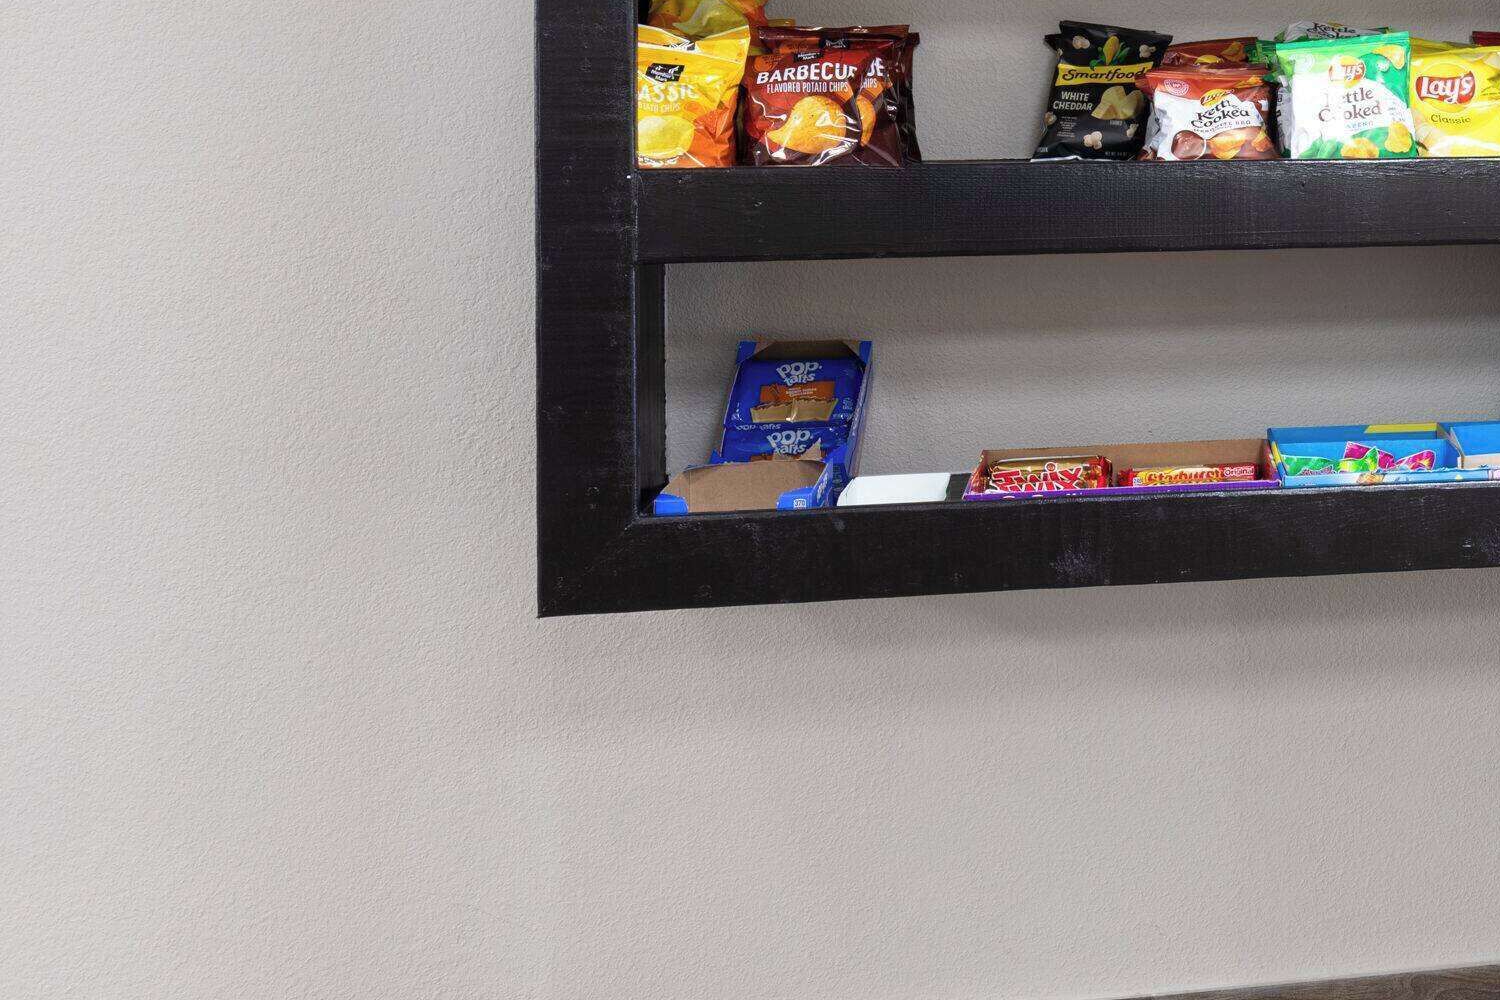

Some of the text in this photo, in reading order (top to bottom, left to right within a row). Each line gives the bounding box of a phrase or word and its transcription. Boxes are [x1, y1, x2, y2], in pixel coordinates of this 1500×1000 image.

[756, 61, 858, 85] BARBECUE
[1062, 66, 1147, 81] Smartfood
[767, 81, 849, 94] FLAVORED POTATO CHIPS
[860, 77, 878, 89] HIPS
[1420, 73, 1474, 105] Lay's
[637, 81, 701, 104] ASSIC
[1060, 91, 1090, 102] WHITE
[1053, 100, 1093, 111] CHEDDAR
[1223, 465, 1256, 477] Original
